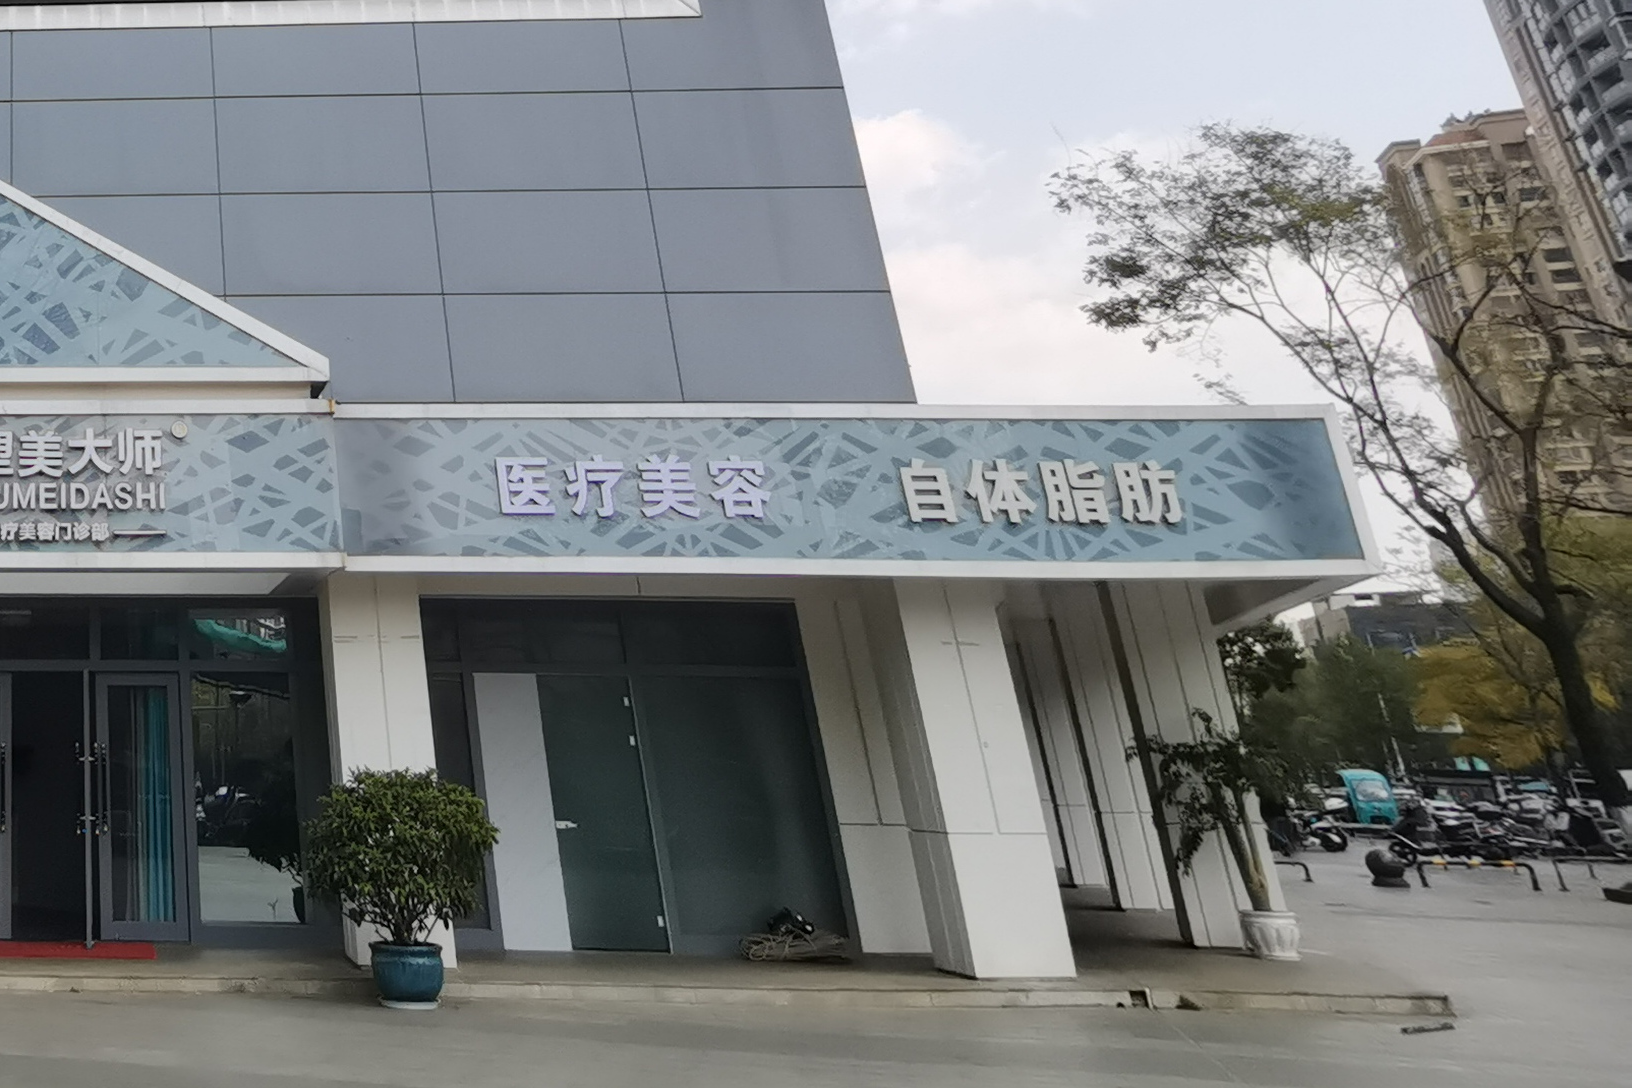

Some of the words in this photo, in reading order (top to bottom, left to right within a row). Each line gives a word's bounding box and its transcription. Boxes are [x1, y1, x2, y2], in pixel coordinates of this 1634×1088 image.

[494, 454, 771, 519] 医疗美容
[900, 458, 1184, 524] 自体脂肪
